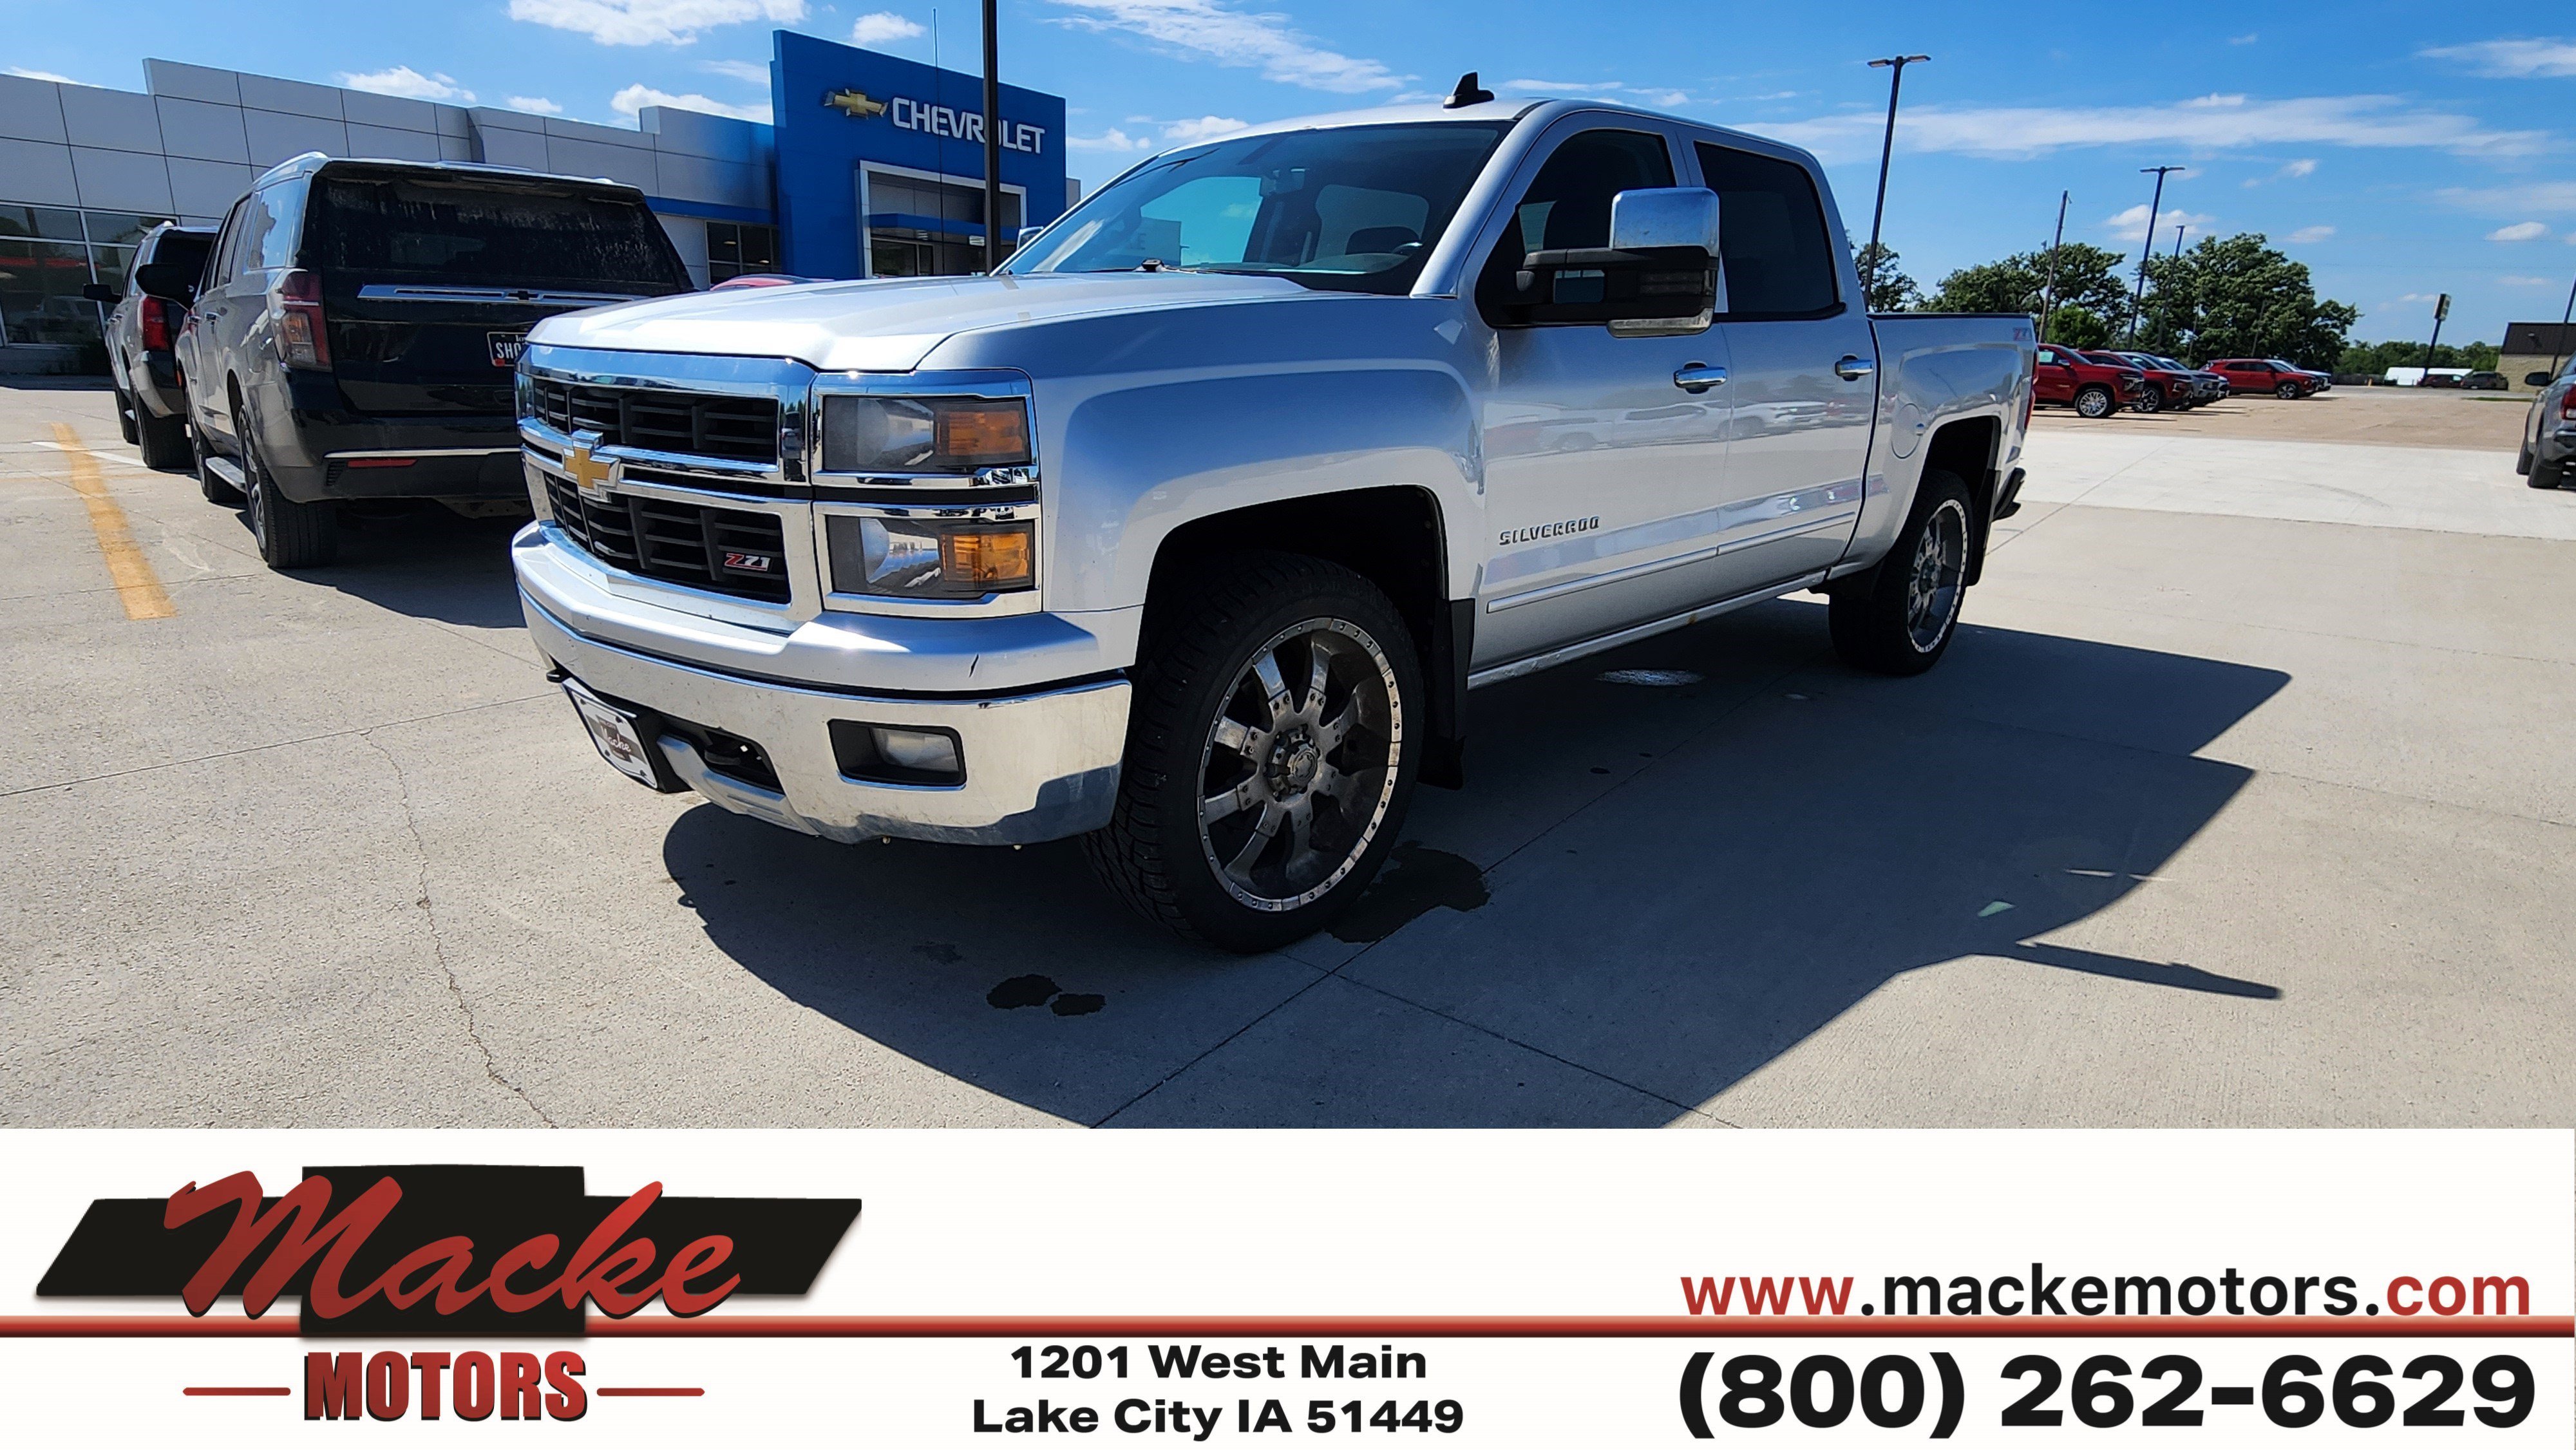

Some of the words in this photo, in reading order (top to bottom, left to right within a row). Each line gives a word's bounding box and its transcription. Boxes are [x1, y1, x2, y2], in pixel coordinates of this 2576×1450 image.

[893, 97, 1046, 154] CHEVRLET
[1499, 516, 1600, 546] SILVERADO
[724, 552, 771, 572] Z71
